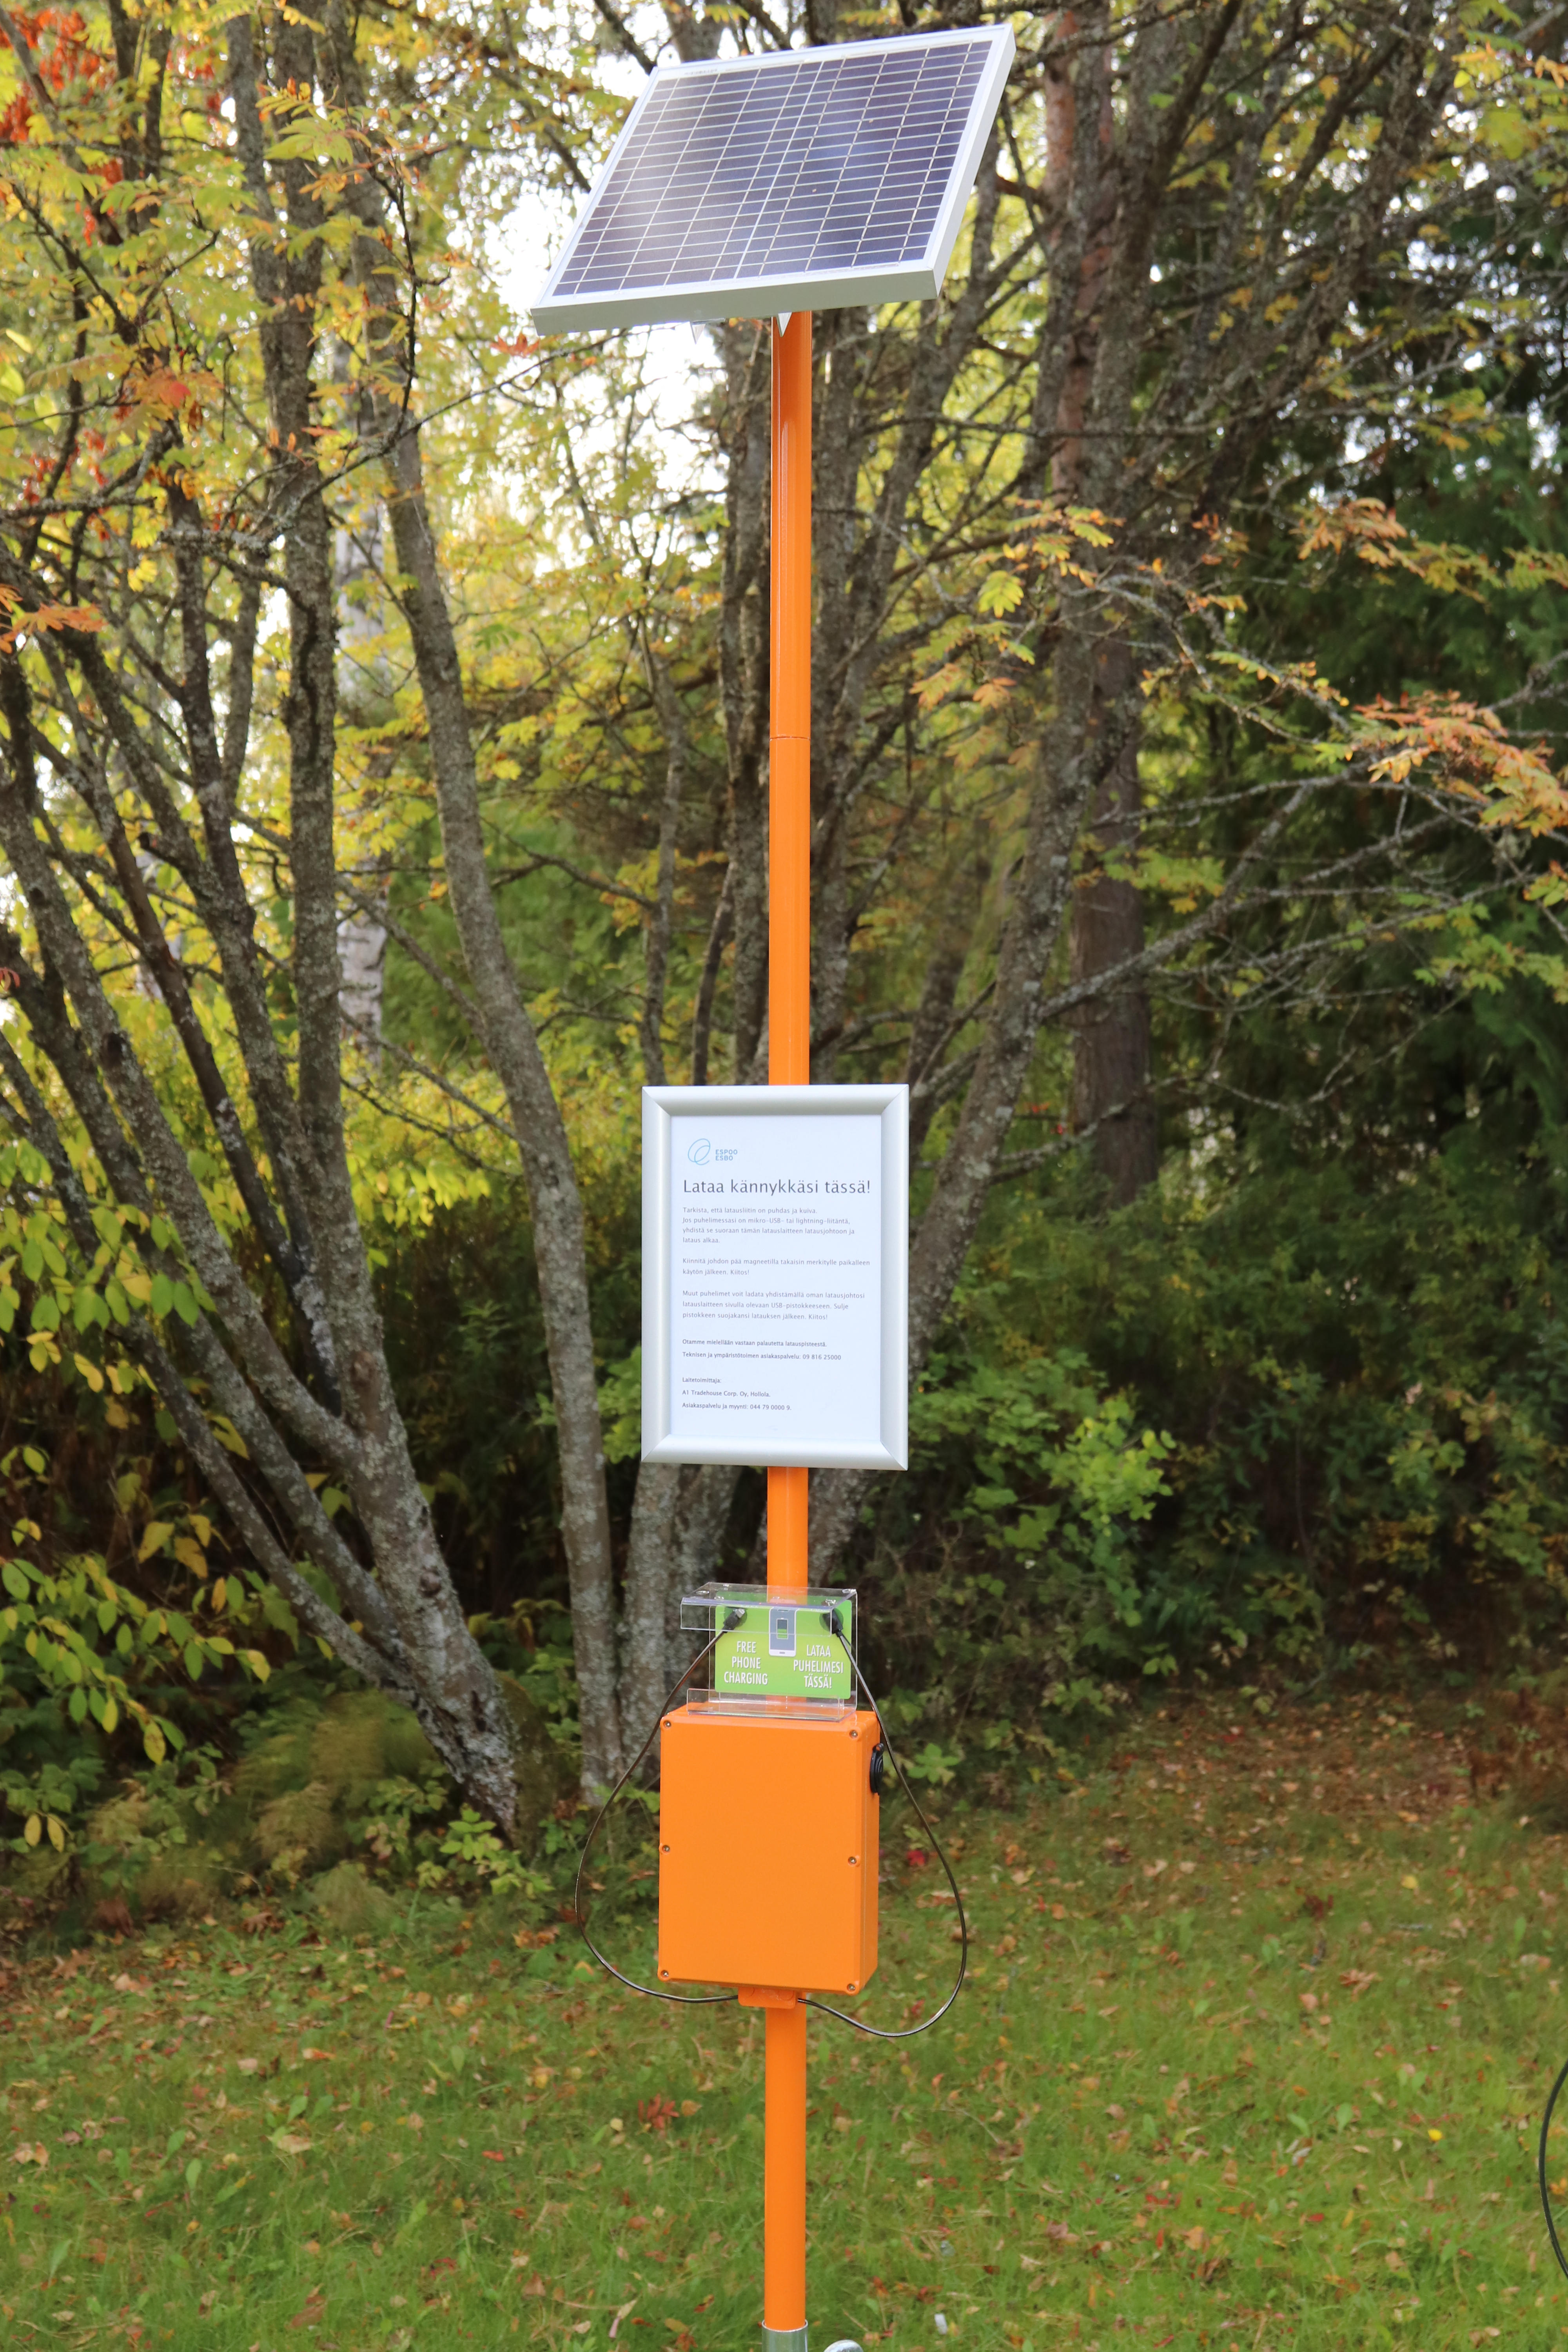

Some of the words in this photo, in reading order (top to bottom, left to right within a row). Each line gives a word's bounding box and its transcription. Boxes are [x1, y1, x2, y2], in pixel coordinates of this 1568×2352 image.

[684, 1180, 724, 1193] Lataa
[731, 1179, 818, 1196] kännykkäsi
[825, 1180, 870, 1194] tässä!
[737, 1641, 756, 1653] FREE
[806, 1645, 831, 1657] LATAA
[732, 1656, 761, 1669] PHONE
[793, 1660, 844, 1673] PUHELIMESI
[724, 1671, 768, 1685] CHARGING
[804, 1674, 832, 1689] TÄSSÄ!
